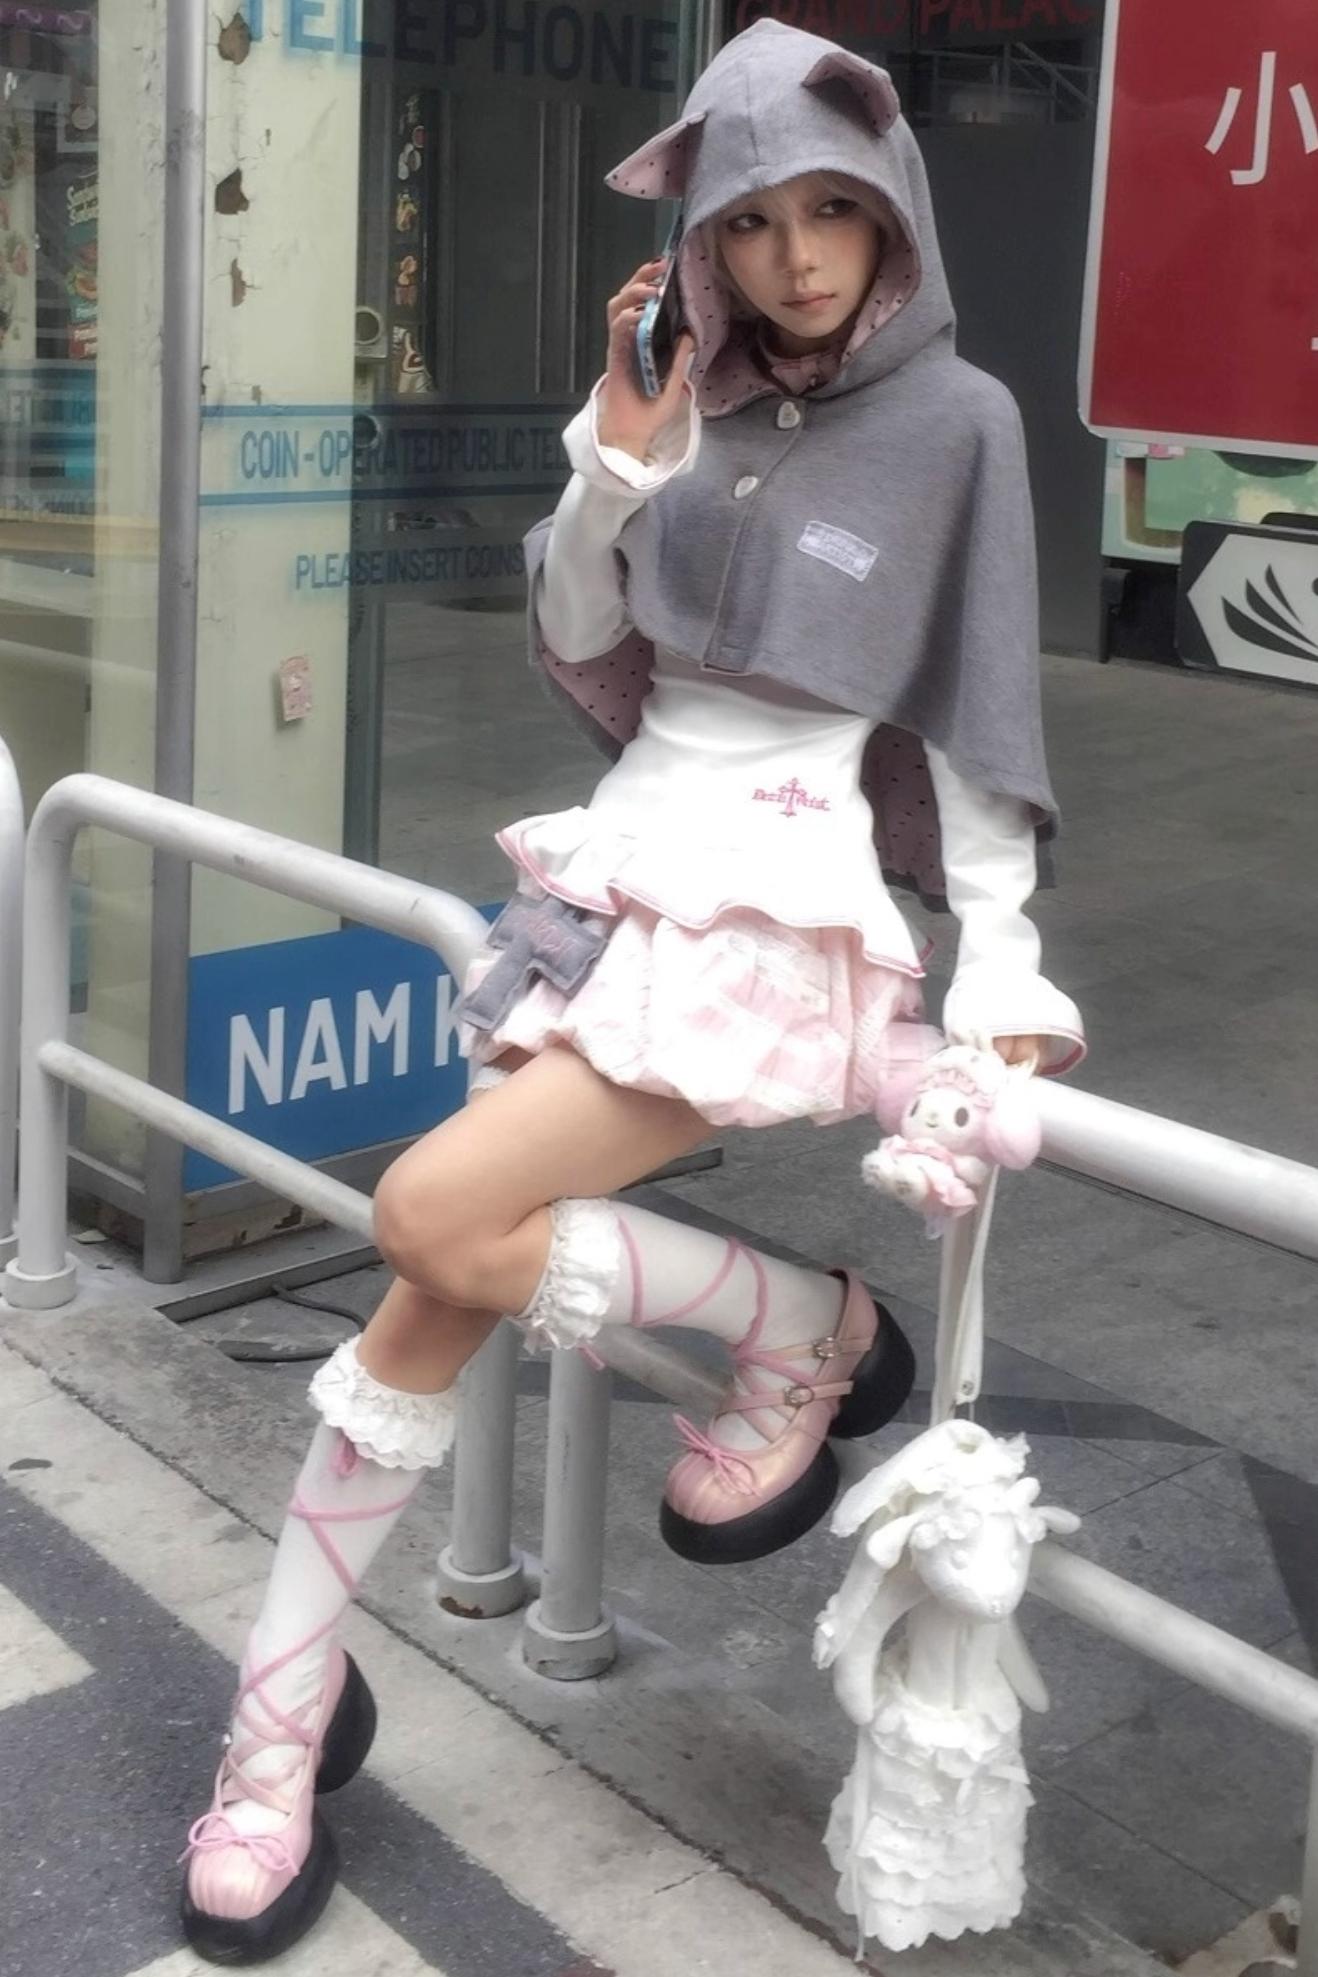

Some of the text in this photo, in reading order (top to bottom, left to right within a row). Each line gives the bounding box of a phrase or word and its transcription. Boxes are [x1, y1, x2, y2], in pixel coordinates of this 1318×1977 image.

[1204, 51, 1318, 185] 小
[447, 427, 524, 472] PUBLIC
[295, 543, 525, 590] PLEASE INSERT COINS
[229, 982, 411, 1115] NAM
